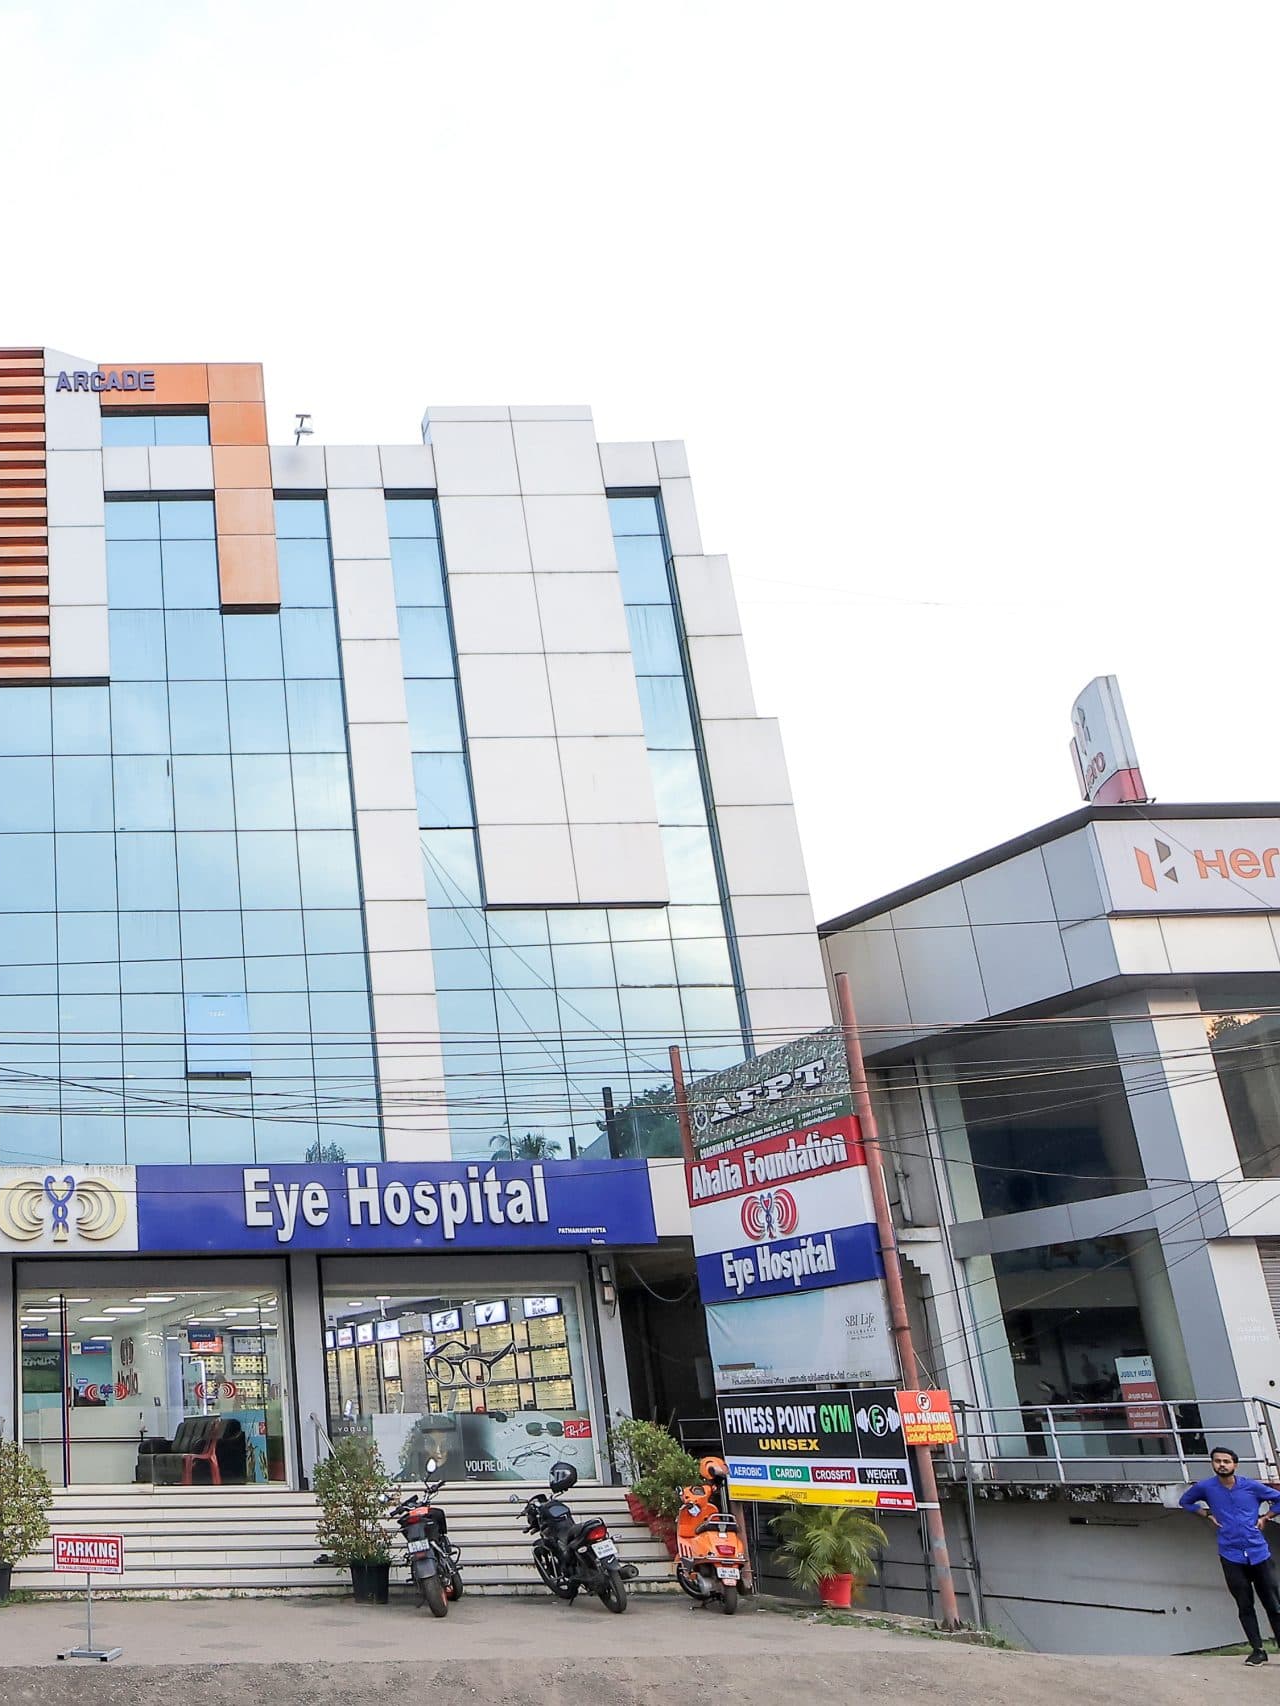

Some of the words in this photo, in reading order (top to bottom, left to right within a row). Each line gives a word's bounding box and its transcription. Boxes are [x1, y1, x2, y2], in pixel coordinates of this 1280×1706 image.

[55, 370, 156, 393] ARCADE
[710, 1057, 827, 1124] AFPT
[691, 1158, 744, 1200] Ahalia
[743, 1131, 848, 1186] Foundation
[243, 1167, 329, 1242] Eye
[346, 1164, 549, 1240] Hospital
[722, 1252, 756, 1295] Eye
[756, 1233, 836, 1286] Hospital
[845, 1314, 858, 1327] SBI
[861, 1312, 875, 1328] Life
[724, 1406, 776, 1434] FITNESS
[777, 1405, 818, 1433] POINT
[820, 1404, 852, 1433] GYM
[903, 1412, 916, 1424] NO
[916, 1411, 951, 1424] PARKING
[337, 1426, 368, 1434] vogue
[759, 1438, 820, 1451] UNISEX
[733, 1466, 763, 1477] AEROBIC
[775, 1468, 802, 1479] CARDIO
[815, 1470, 852, 1481] CROSSFIT
[865, 1469, 898, 1479] WEIGHT
[58, 1541, 117, 1558] PARKING
